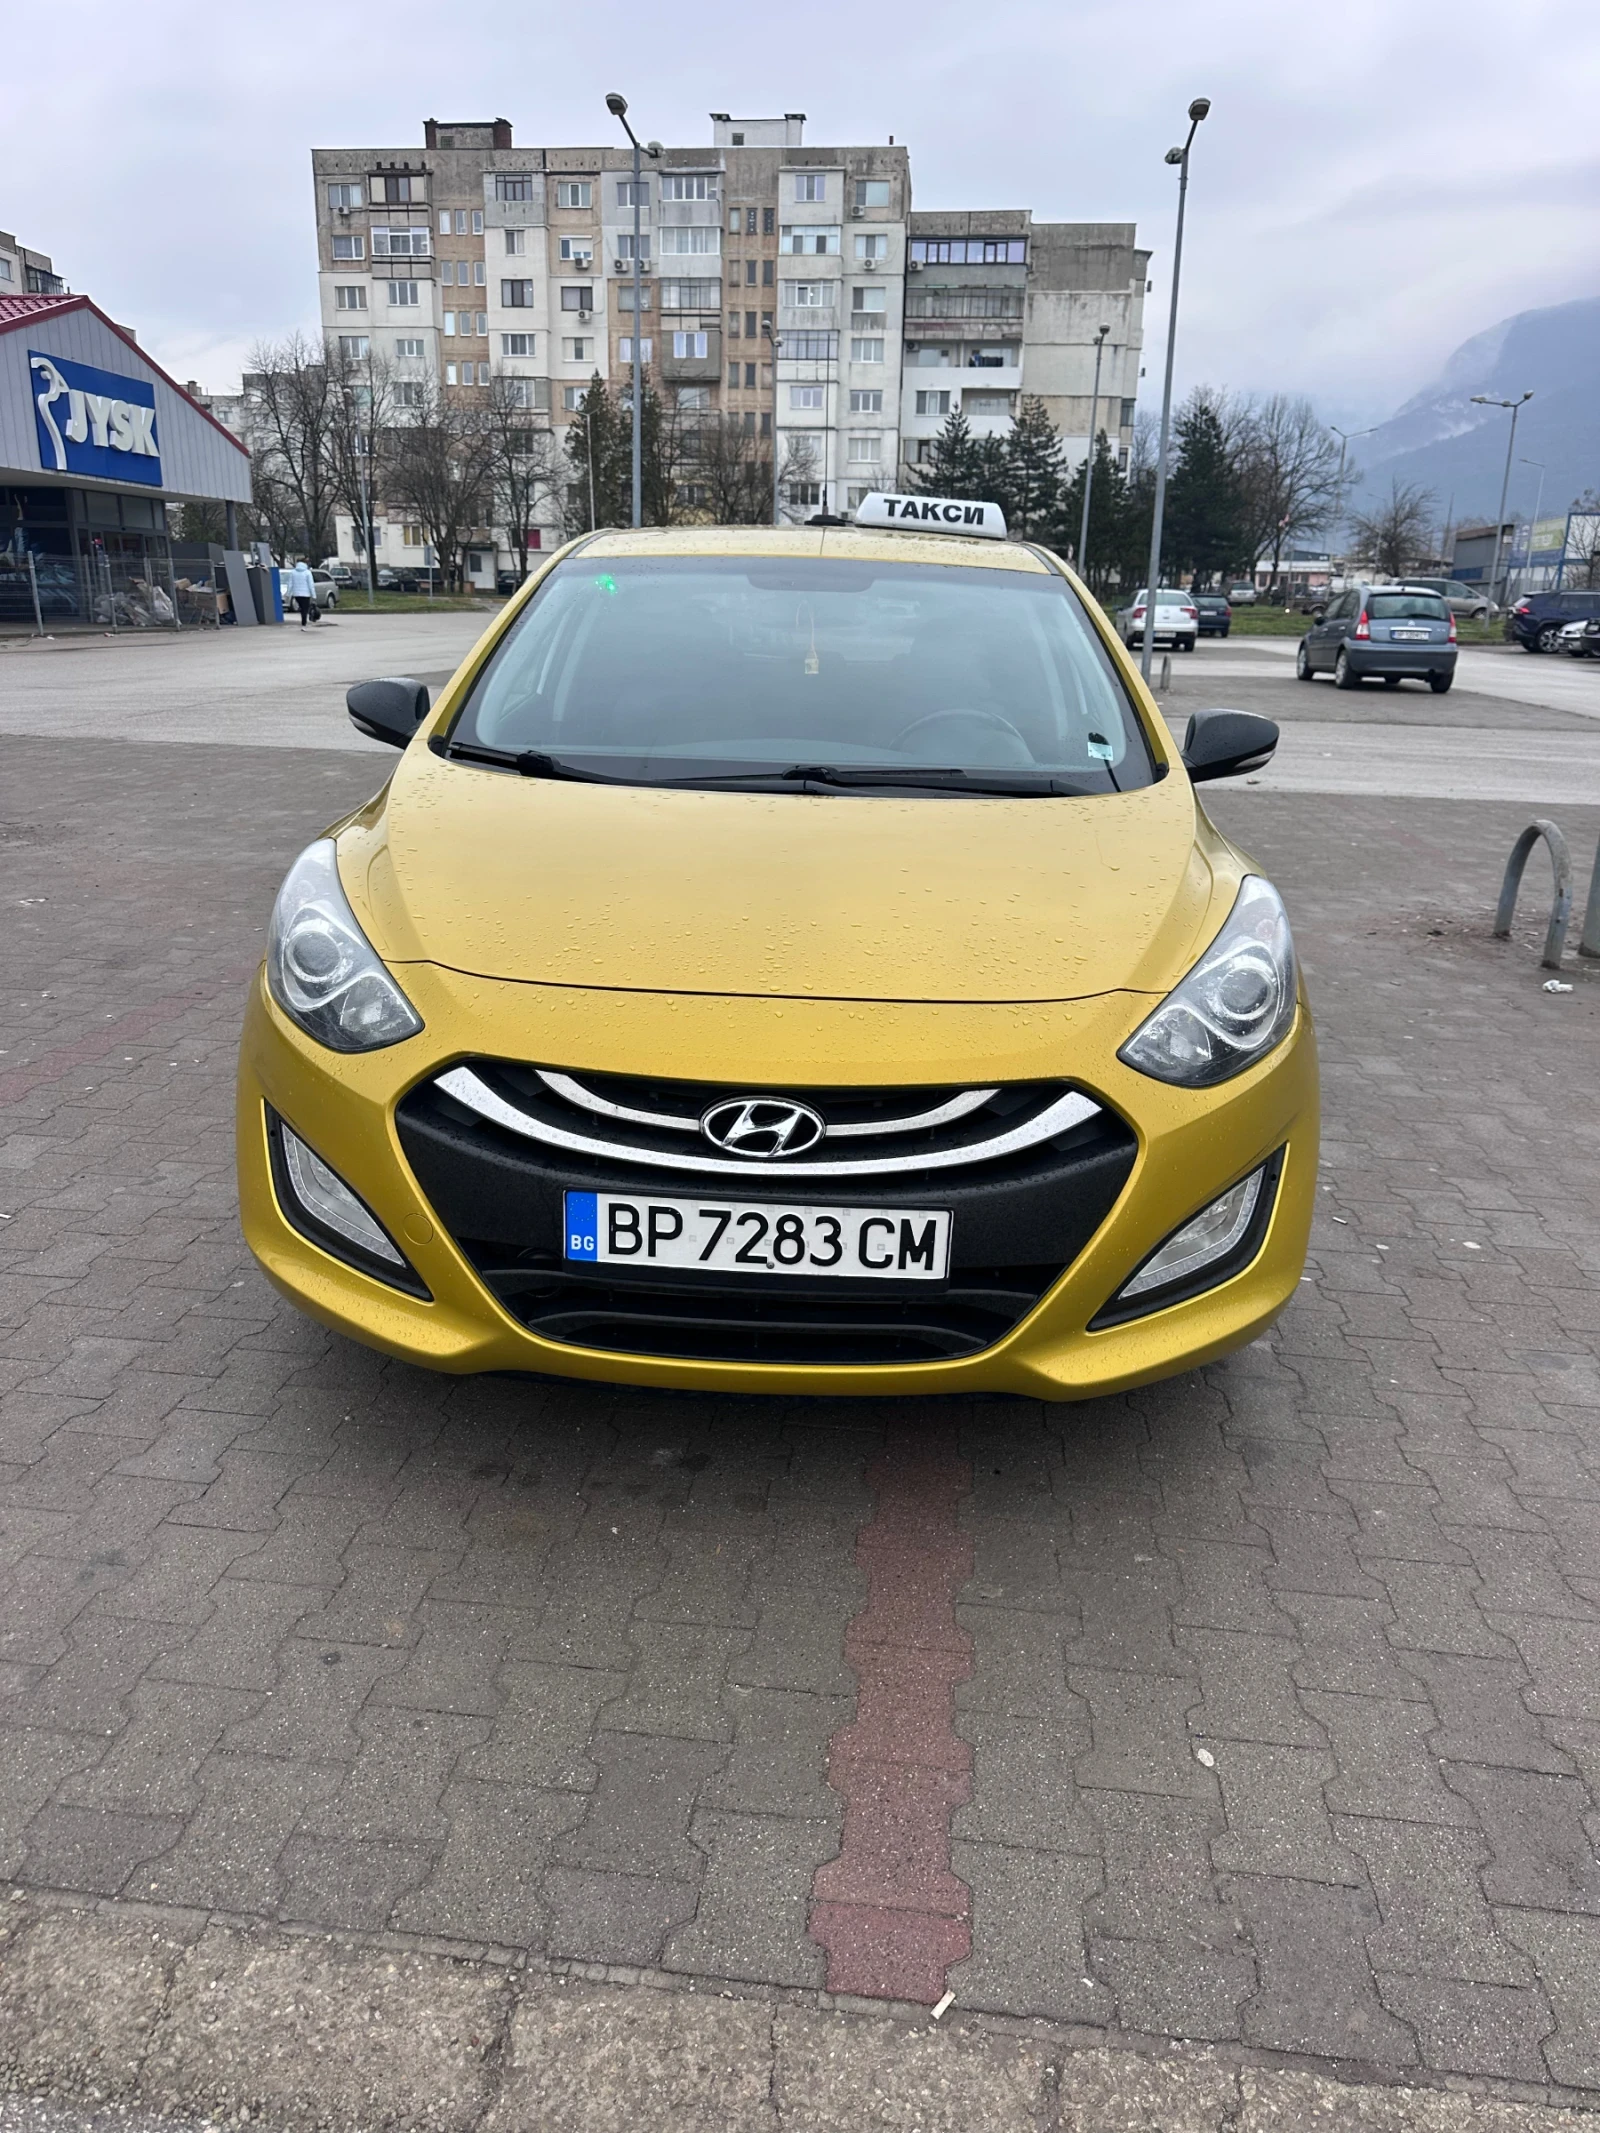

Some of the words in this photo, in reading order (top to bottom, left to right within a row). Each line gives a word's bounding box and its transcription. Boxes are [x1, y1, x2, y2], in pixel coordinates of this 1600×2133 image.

[65, 388, 160, 457] JYSK
[883, 498, 984, 526] ТАКСИ
[571, 1234, 595, 1251] BG
[608, 1203, 684, 1258] BP
[698, 1209, 843, 1267] 7283
[858, 1216, 938, 1271] CM
